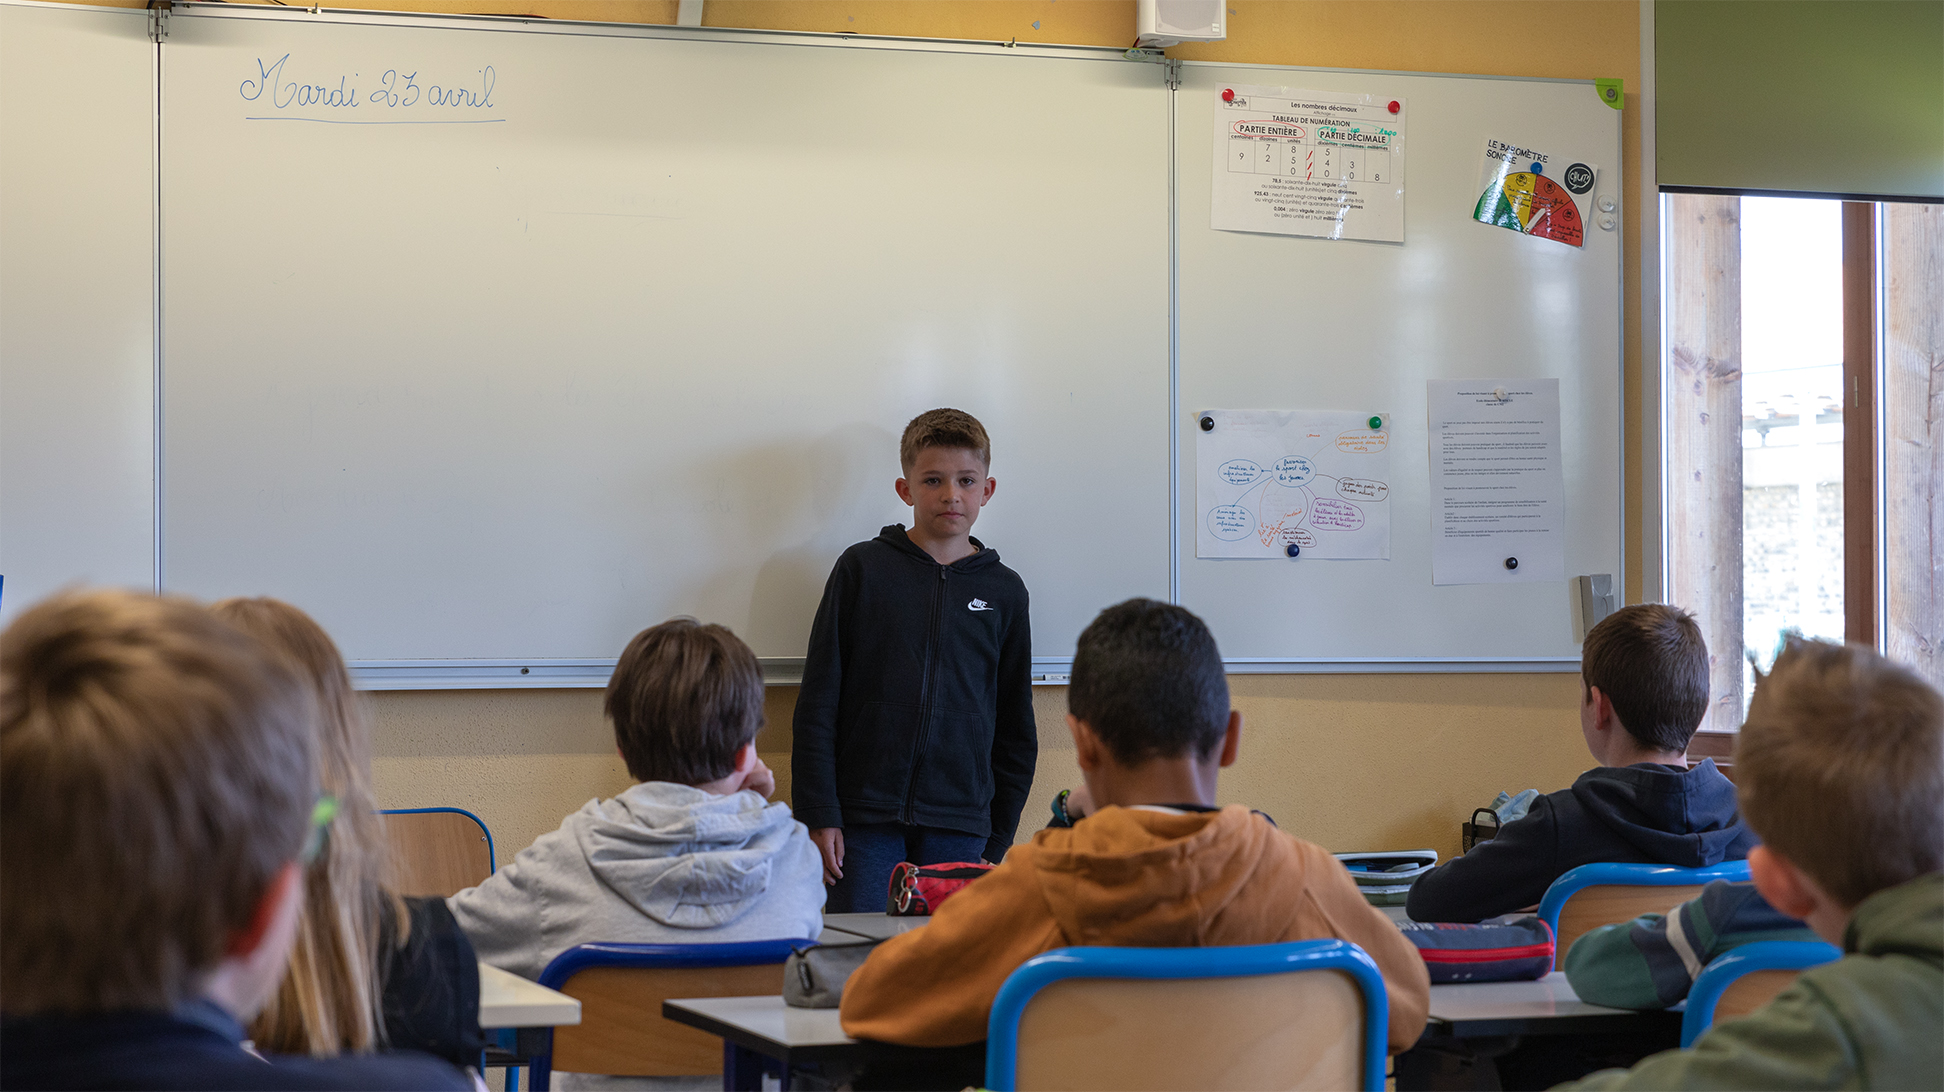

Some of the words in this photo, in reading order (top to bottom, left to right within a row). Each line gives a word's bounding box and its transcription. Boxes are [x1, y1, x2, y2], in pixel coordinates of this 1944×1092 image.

[240, 53, 359, 108] Mardi
[370, 69, 420, 108] 23
[428, 65, 496, 108] avril
[1302, 103, 1327, 111] nombres
[1328, 105, 1358, 113] décimaux
[1272, 115, 1299, 124] TABLEAU
[1310, 118, 1351, 128] NUMÉRATION
[1239, 124, 1266, 134] PARTIE
[1267, 125, 1298, 137] ENTIÈRE
[1320, 130, 1346, 141] PARTIE
[1347, 132, 1386, 144] DÉCIMALE
[1266, 143, 1271, 152] 7
[1290, 146, 1297, 154] 8
[1325, 148, 1331, 157] 5
[1488, 139, 1498, 149] LE
[1500, 142, 1549, 164] BAROMÈTRE
[1238, 152, 1245, 161] 9
[1265, 154, 1271, 163] 2
[1290, 156, 1297, 165] 5
[1324, 159, 1330, 167] 4
[1349, 160, 1355, 169] 3
[1290, 167, 1296, 176] 0
[1324, 169, 1330, 178] 0
[1348, 171, 1355, 180] 0
[1374, 173, 1380, 182] 8
[972, 598, 988, 609] NIKE
